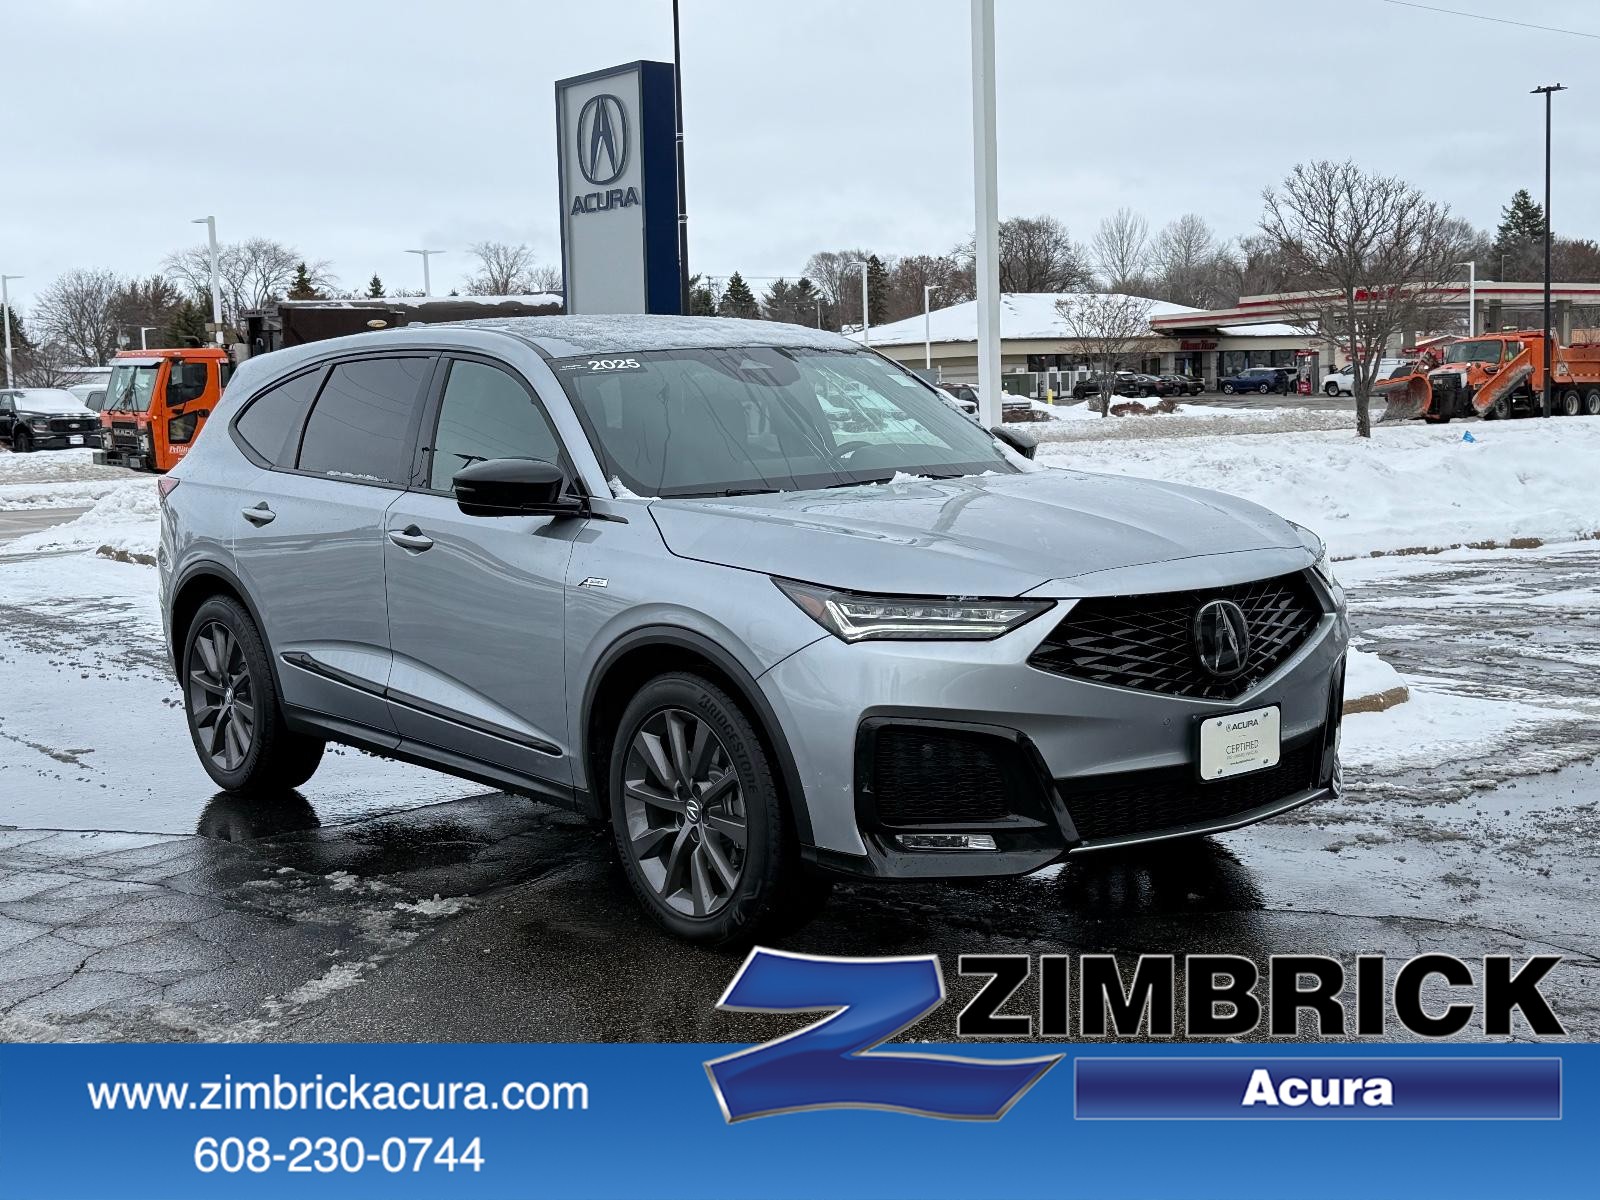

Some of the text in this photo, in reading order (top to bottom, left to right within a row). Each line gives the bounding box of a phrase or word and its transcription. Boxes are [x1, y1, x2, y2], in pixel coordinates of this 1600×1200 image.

[571, 186, 639, 216] ACURA
[587, 358, 641, 371] 2025
[113, 428, 135, 437] MACK
[1231, 719, 1259, 731] ACURA
[698, 694, 759, 794] BRIDGESTONE
[1225, 739, 1259, 755] CERTIFIED
